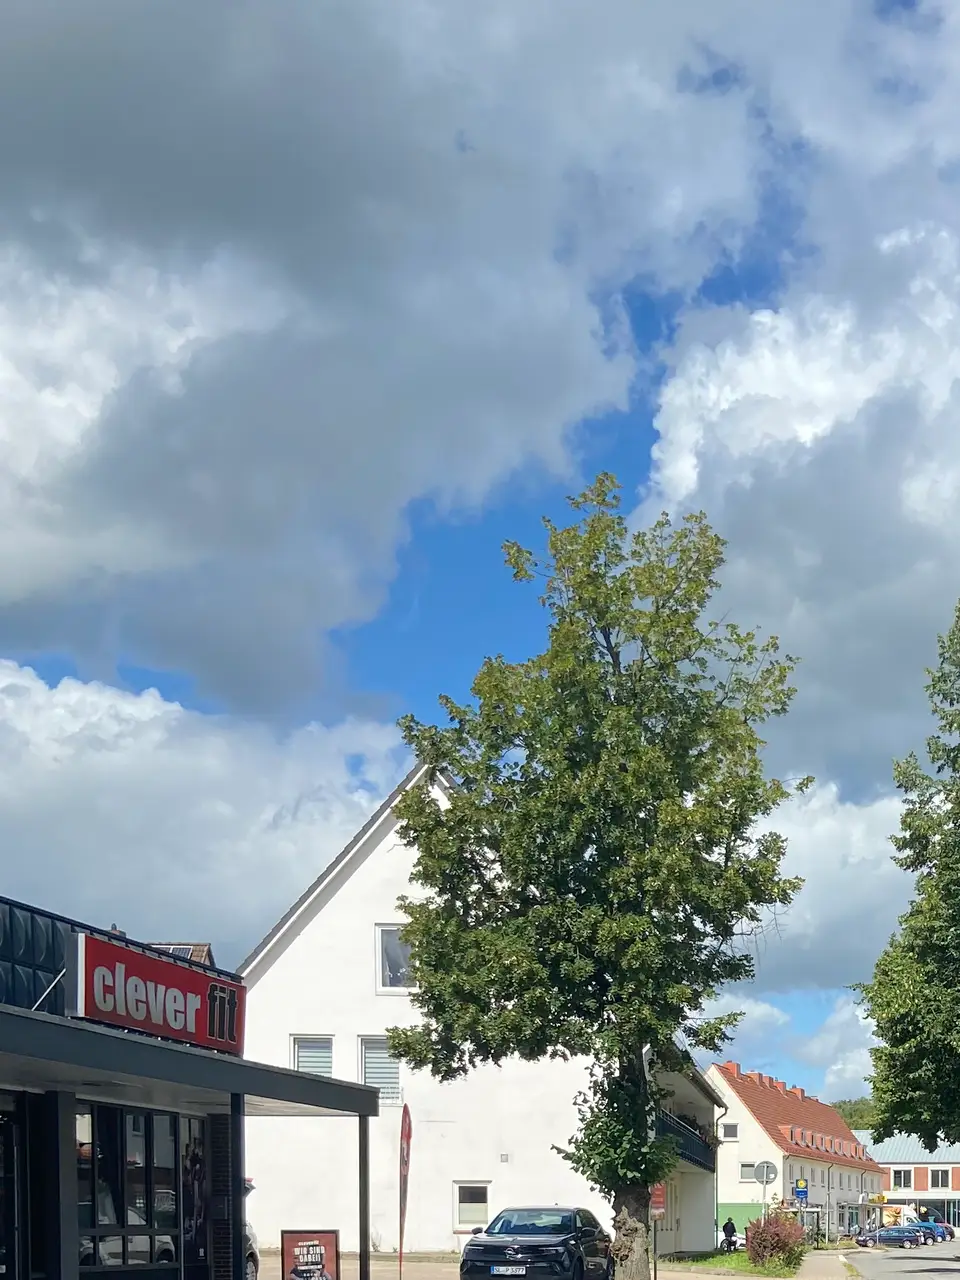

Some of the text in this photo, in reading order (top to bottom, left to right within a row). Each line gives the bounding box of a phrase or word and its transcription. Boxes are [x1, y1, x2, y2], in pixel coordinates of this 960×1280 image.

[93, 961, 238, 1045] clever fit
[294, 1246, 325, 1255] WIR SIND
